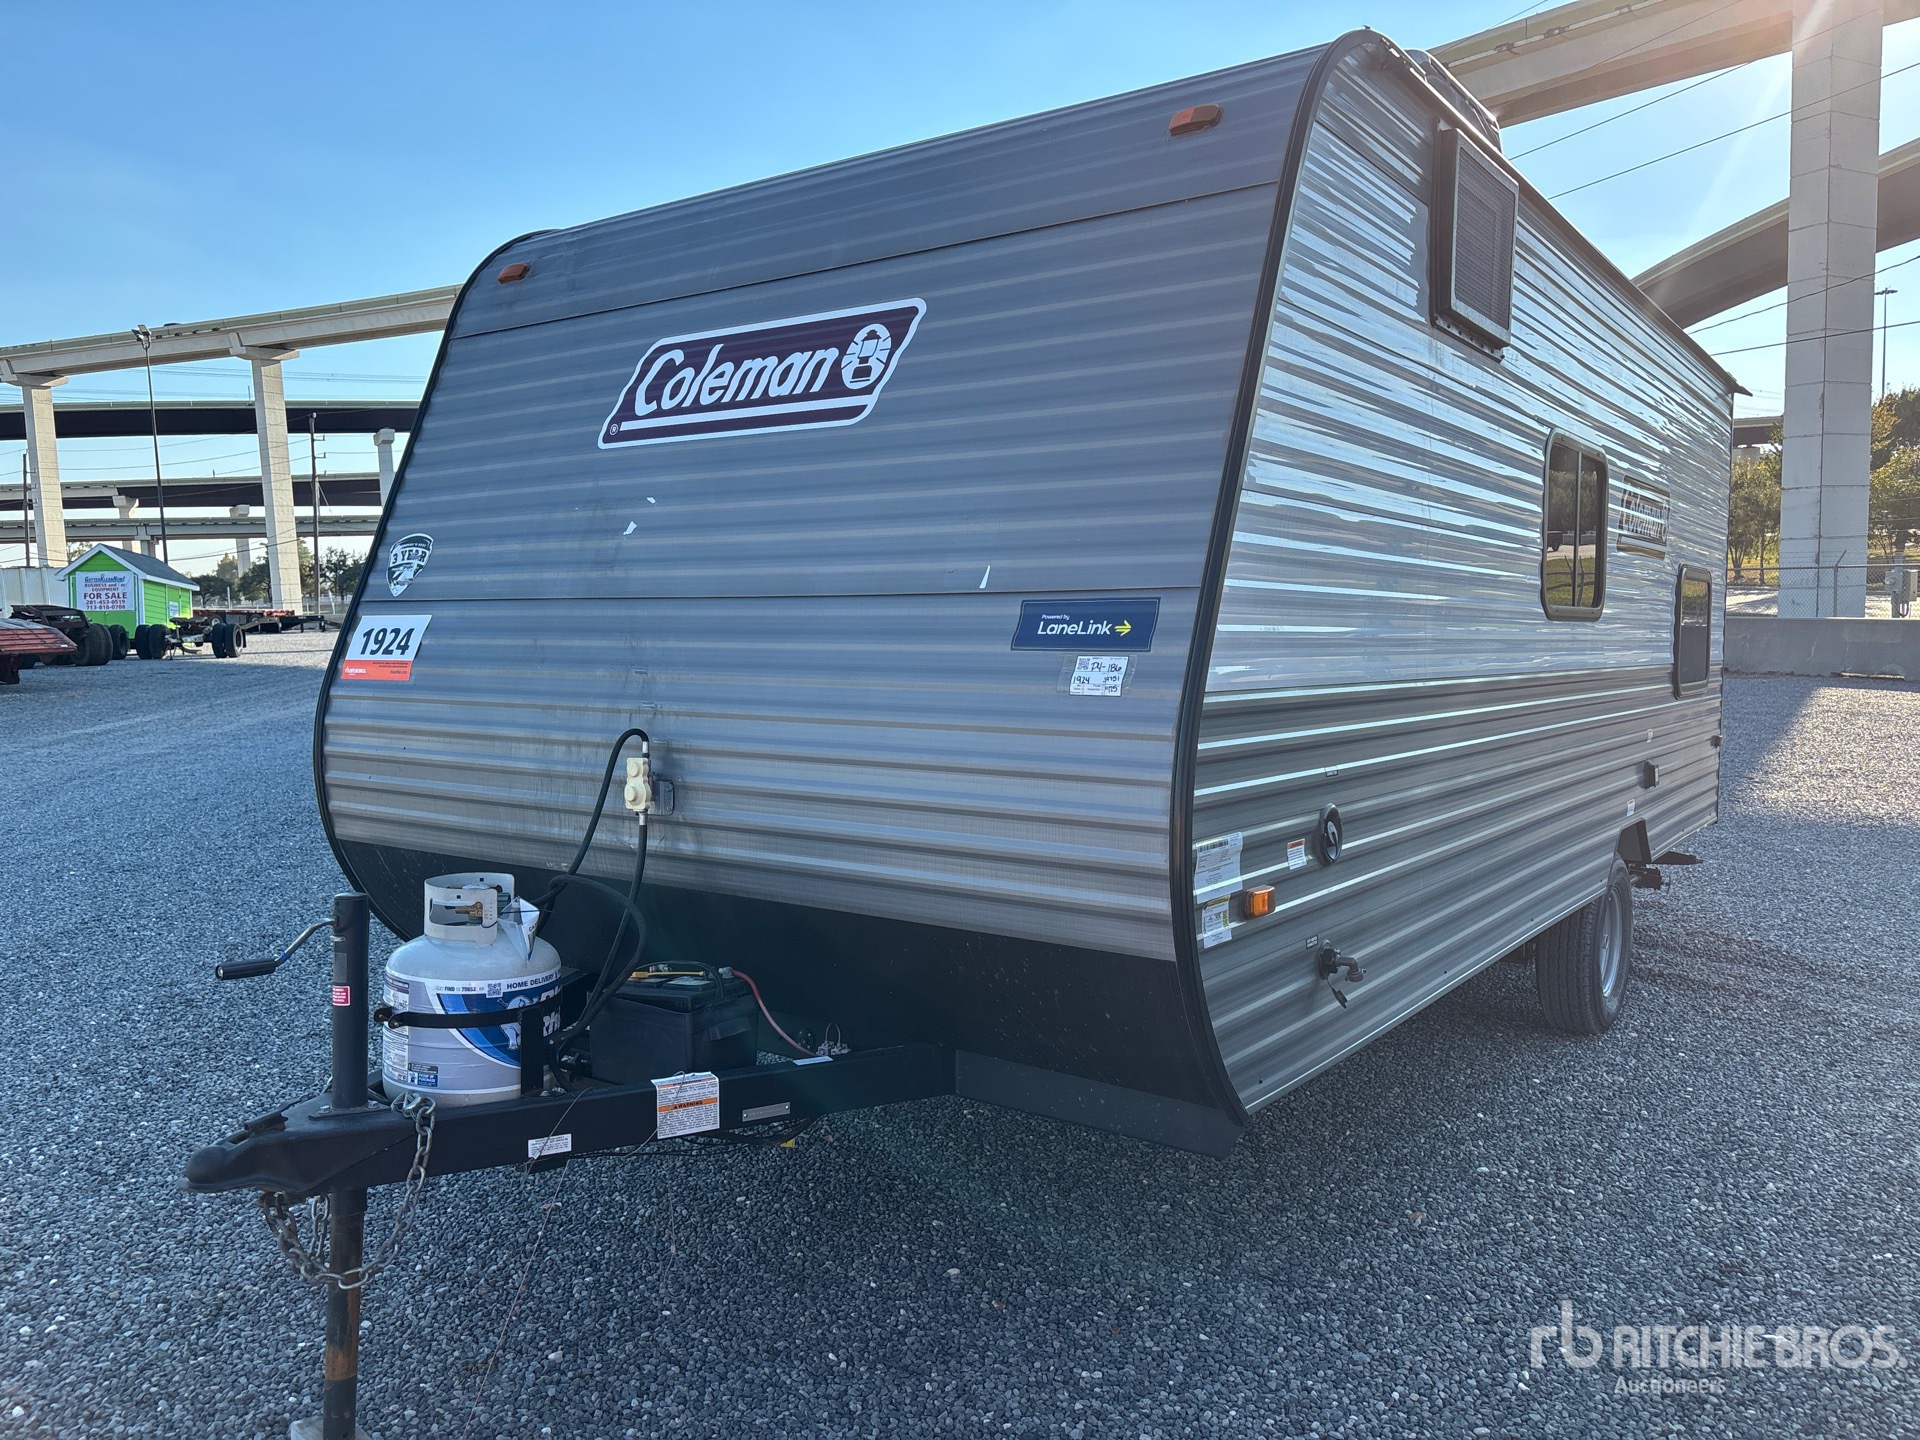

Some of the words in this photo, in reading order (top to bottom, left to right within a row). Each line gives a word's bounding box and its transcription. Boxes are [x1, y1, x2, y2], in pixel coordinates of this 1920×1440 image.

[634, 344, 839, 417] Coleman
[391, 553, 399, 565] 3
[1037, 619, 1112, 635] LaneLink
[360, 627, 415, 656] 1924
[1073, 675, 1090, 684] 1924
[506, 980, 528, 990] HOME
[529, 974, 554, 986] DELIVERY
[678, 1100, 703, 1108] WARNING
